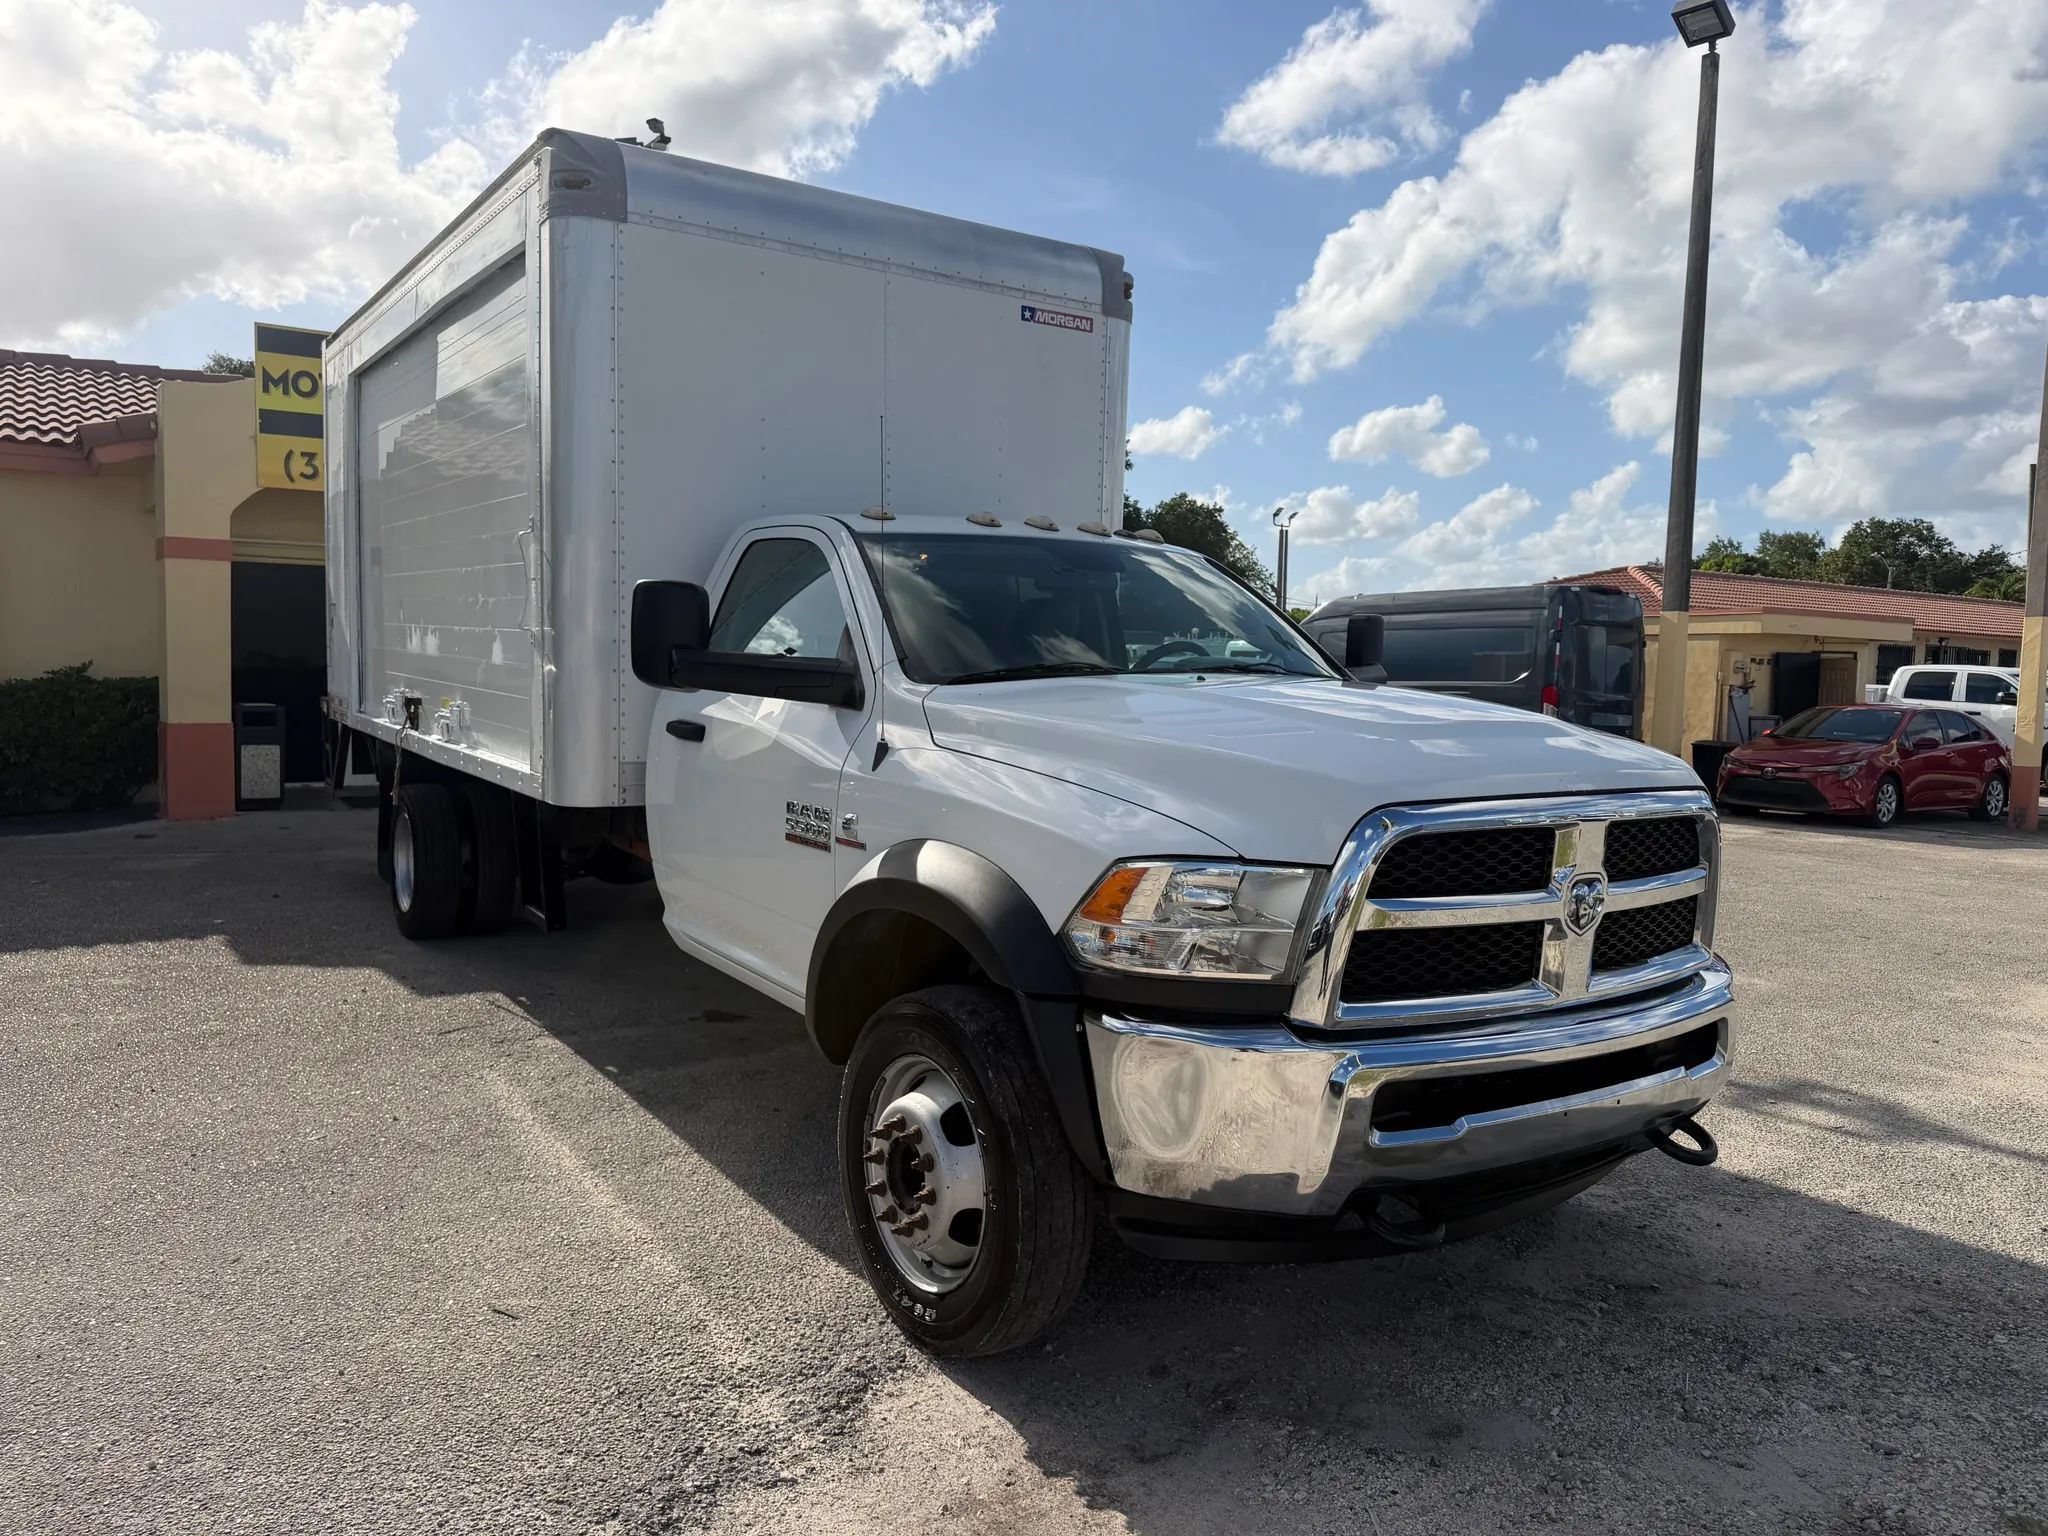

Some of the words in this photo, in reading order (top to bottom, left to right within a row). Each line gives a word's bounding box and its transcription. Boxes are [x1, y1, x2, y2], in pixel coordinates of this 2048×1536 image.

[1035, 311, 1091, 331] MORGAN
[262, 366, 323, 399] MO
[284, 449, 324, 484] (3
[786, 800, 832, 824] RAM
